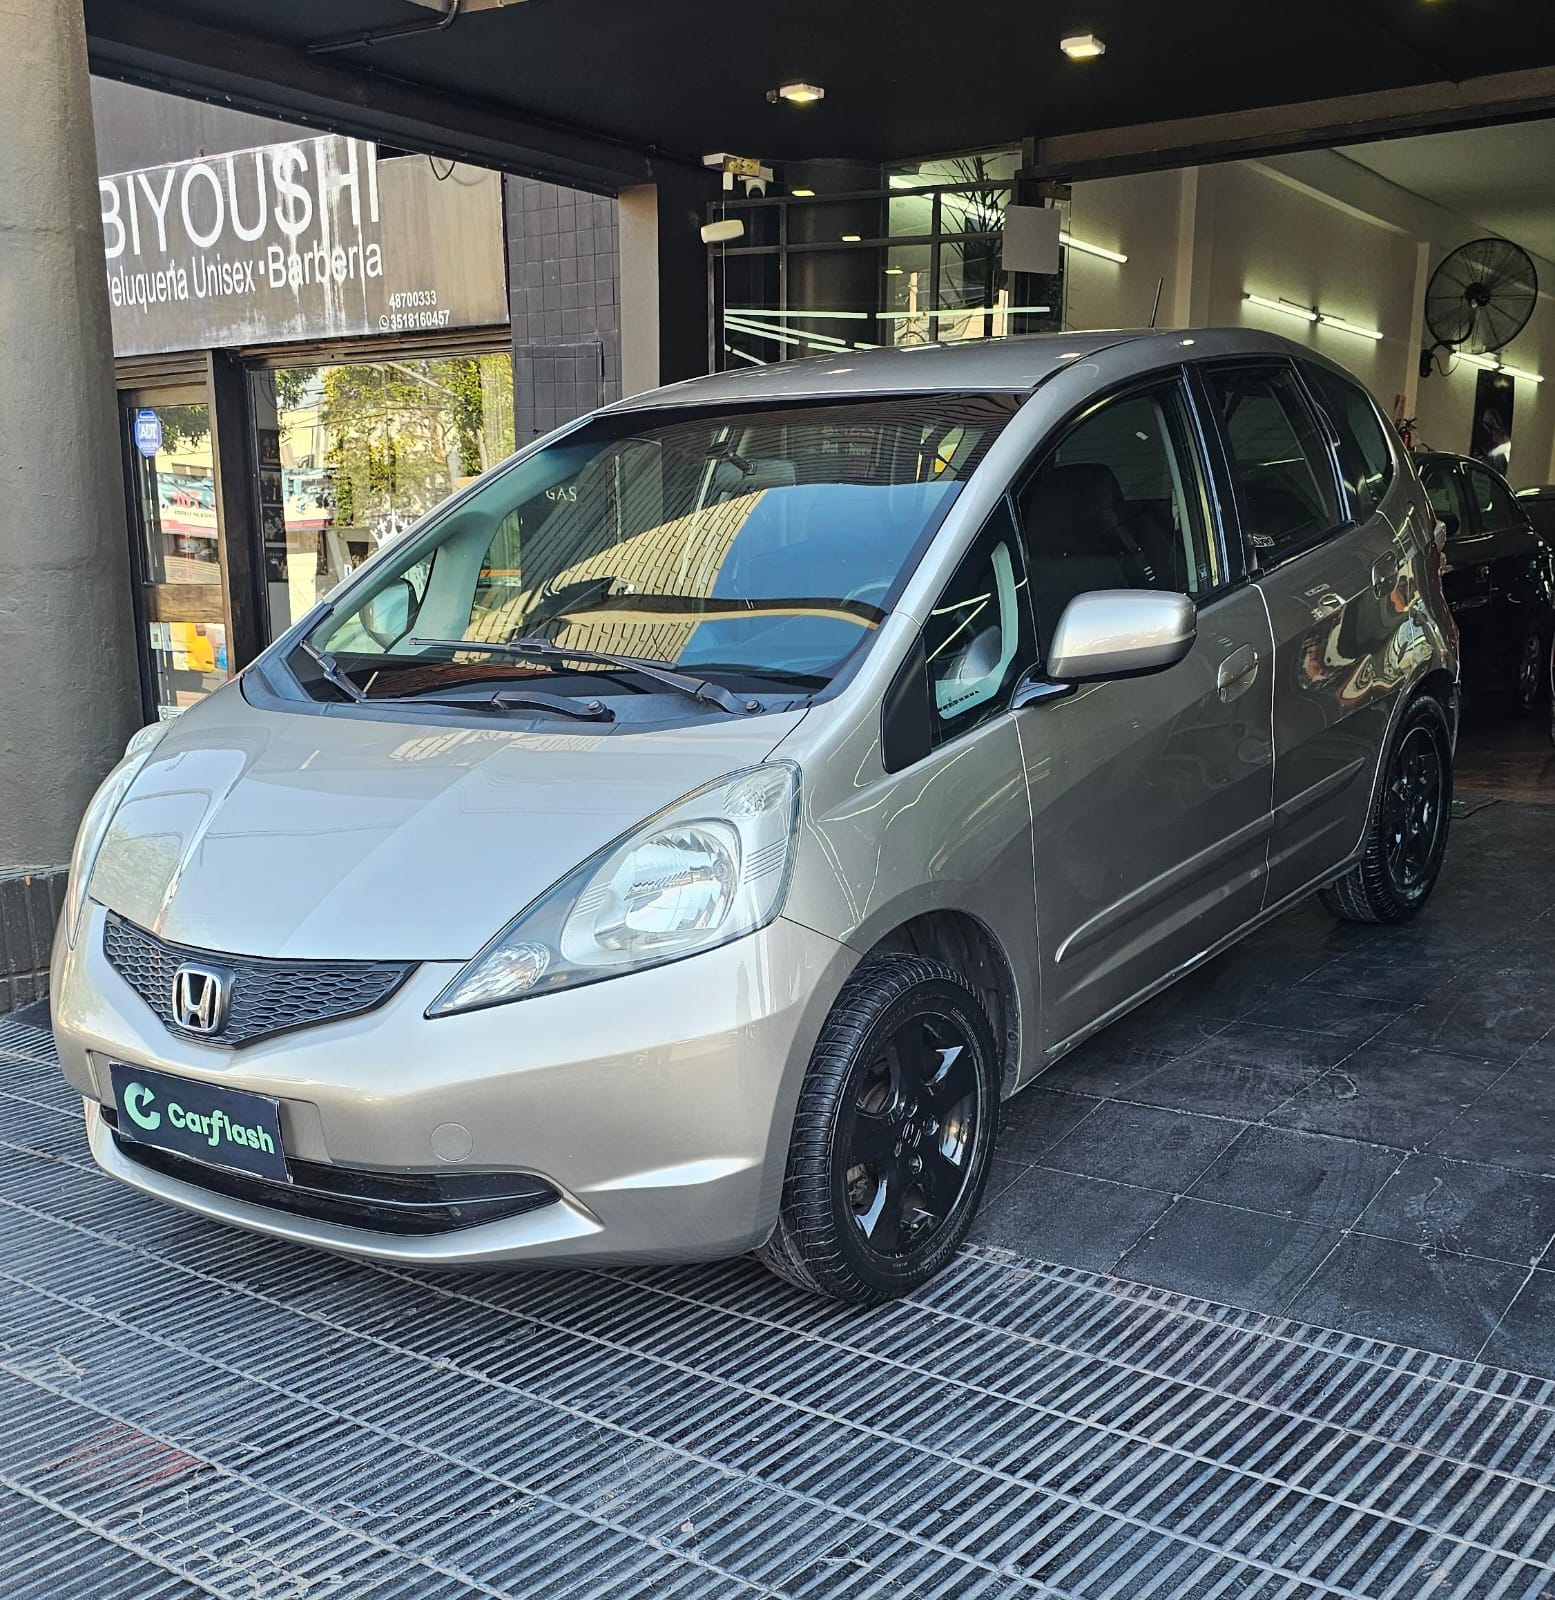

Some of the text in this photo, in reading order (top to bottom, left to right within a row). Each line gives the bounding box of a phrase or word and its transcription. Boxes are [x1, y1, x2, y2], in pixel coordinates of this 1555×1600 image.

[99, 136, 380, 259] BIYOUSHI
[107, 259, 189, 314] eluquería
[192, 253, 256, 298] Unisex
[389, 290, 437, 312] 48700333
[390, 310, 450, 330] 3518160457
[545, 486, 577, 502] GAS
[167, 1102, 275, 1155] Carflash
